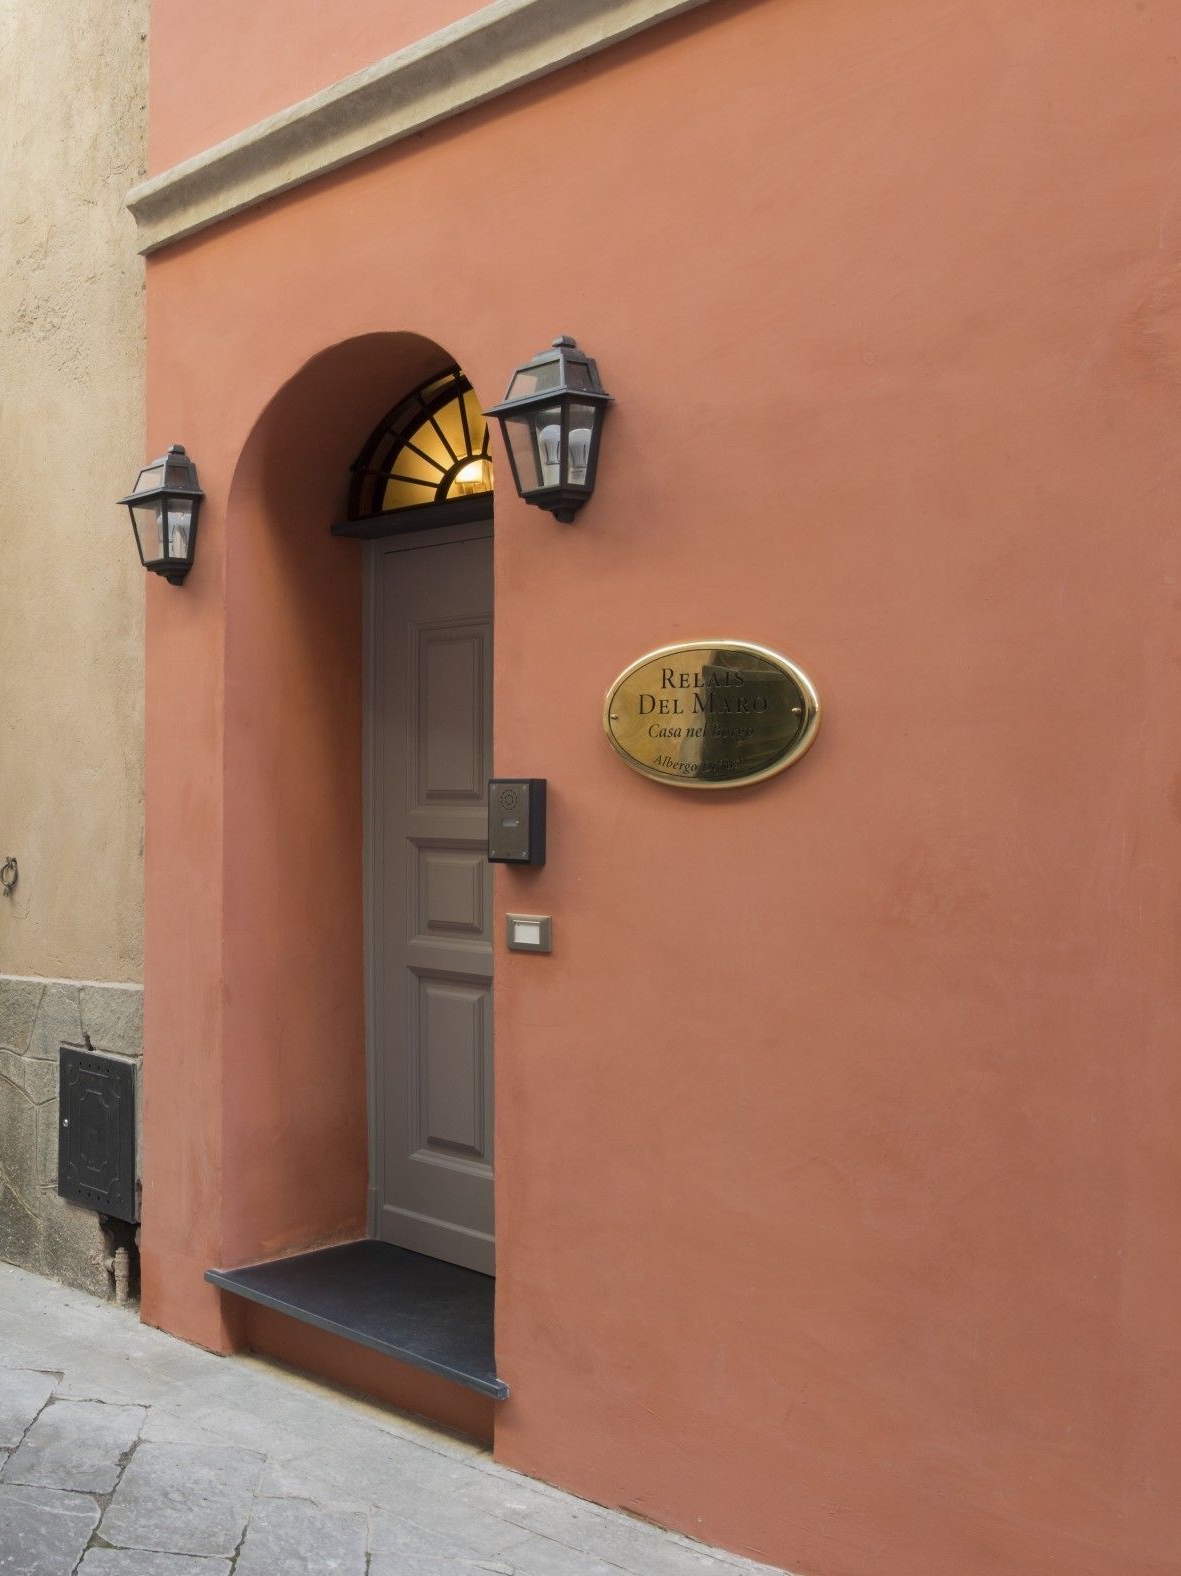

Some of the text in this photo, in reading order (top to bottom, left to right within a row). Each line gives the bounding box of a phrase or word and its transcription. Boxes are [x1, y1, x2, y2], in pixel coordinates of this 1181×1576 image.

[661, 667, 746, 689] RELAIS
[639, 692, 768, 715] DEL MARO
[648, 723, 681, 739] Casa
[686, 722, 707, 738] nel
[653, 755, 698, 774] Albergo
